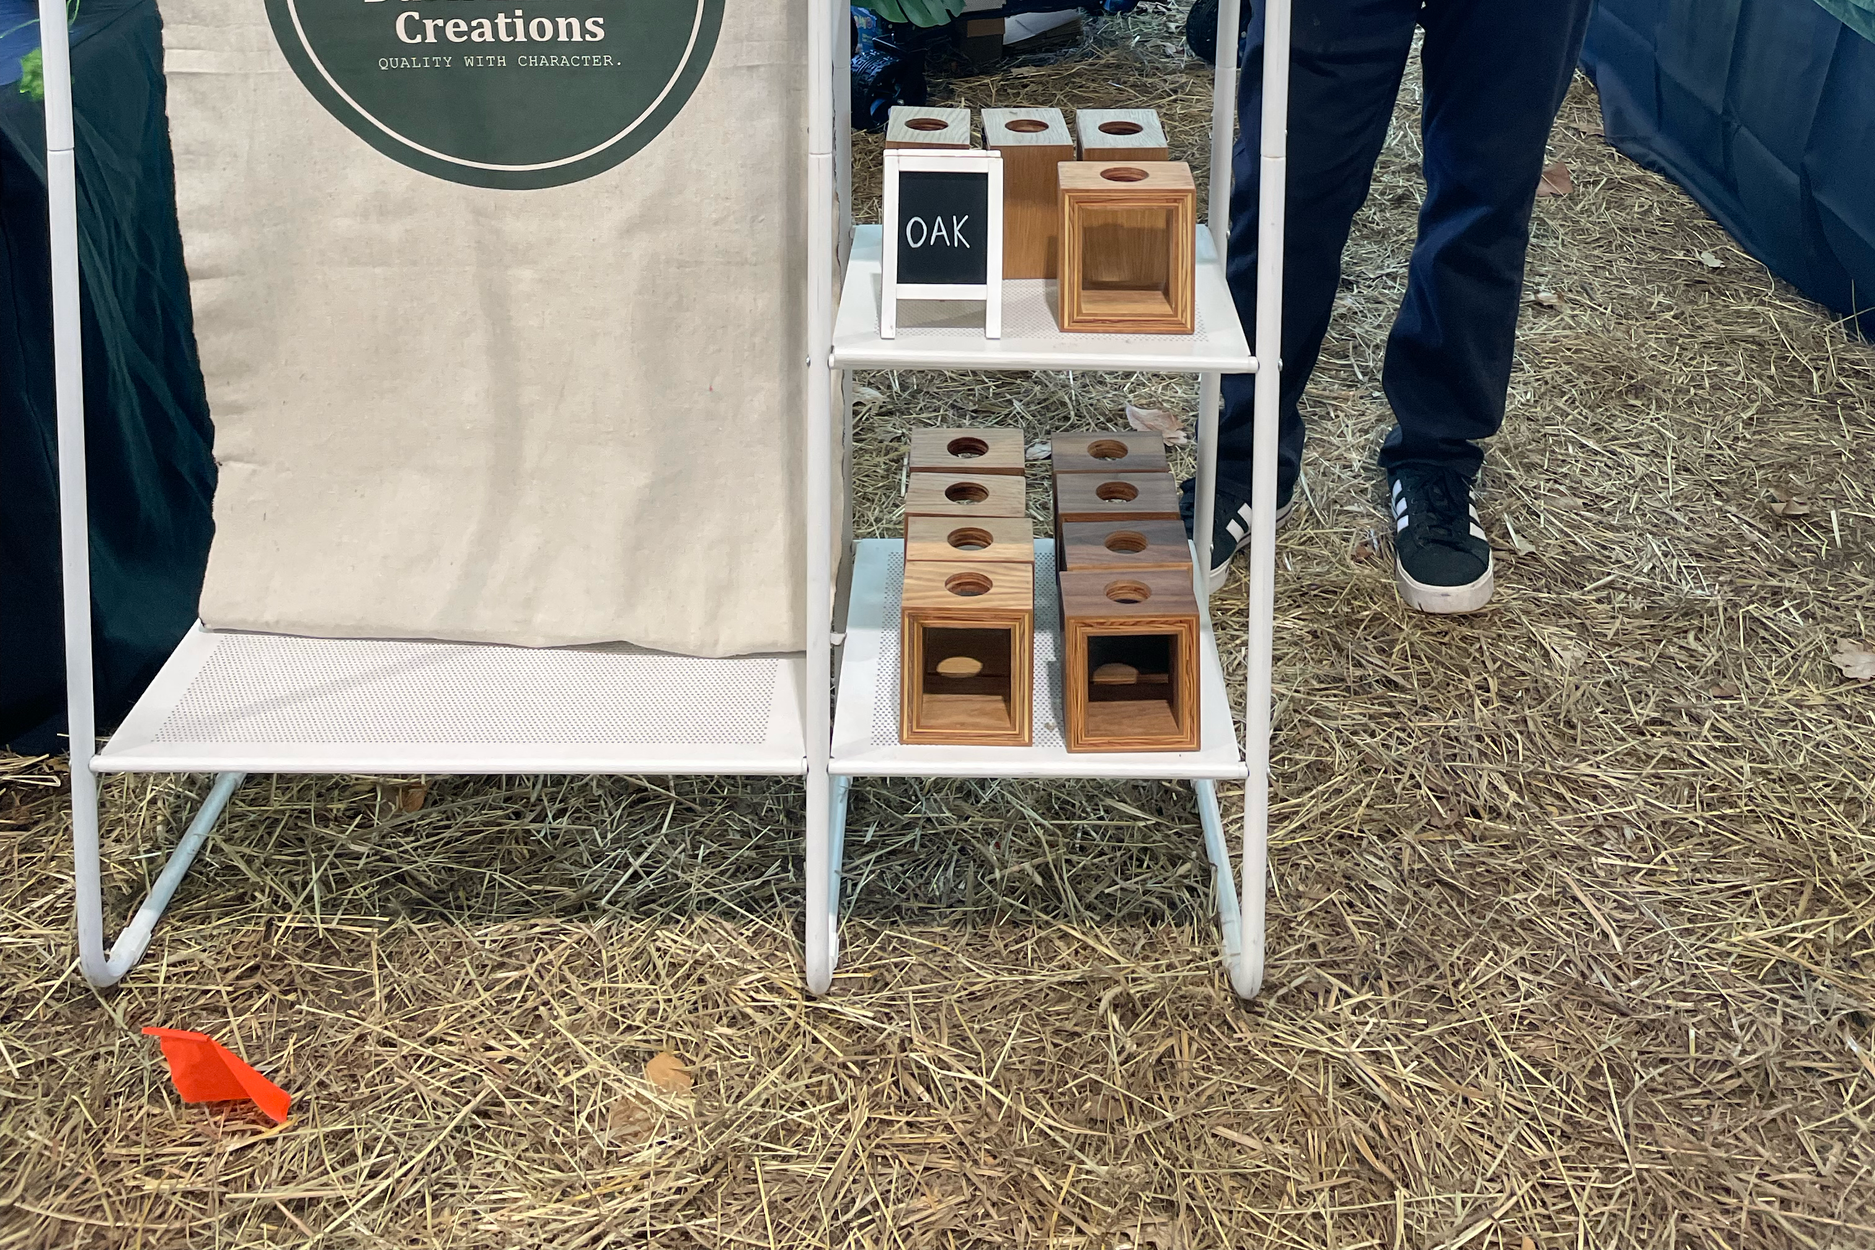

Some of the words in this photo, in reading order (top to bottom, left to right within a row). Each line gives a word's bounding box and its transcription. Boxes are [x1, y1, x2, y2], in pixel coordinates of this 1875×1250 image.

[395, 9, 606, 44] Creations
[378, 56, 453, 71] QUALITY
[463, 55, 507, 68] WITH
[517, 54, 622, 67] CHARACTER.
[905, 214, 971, 249] OAK
